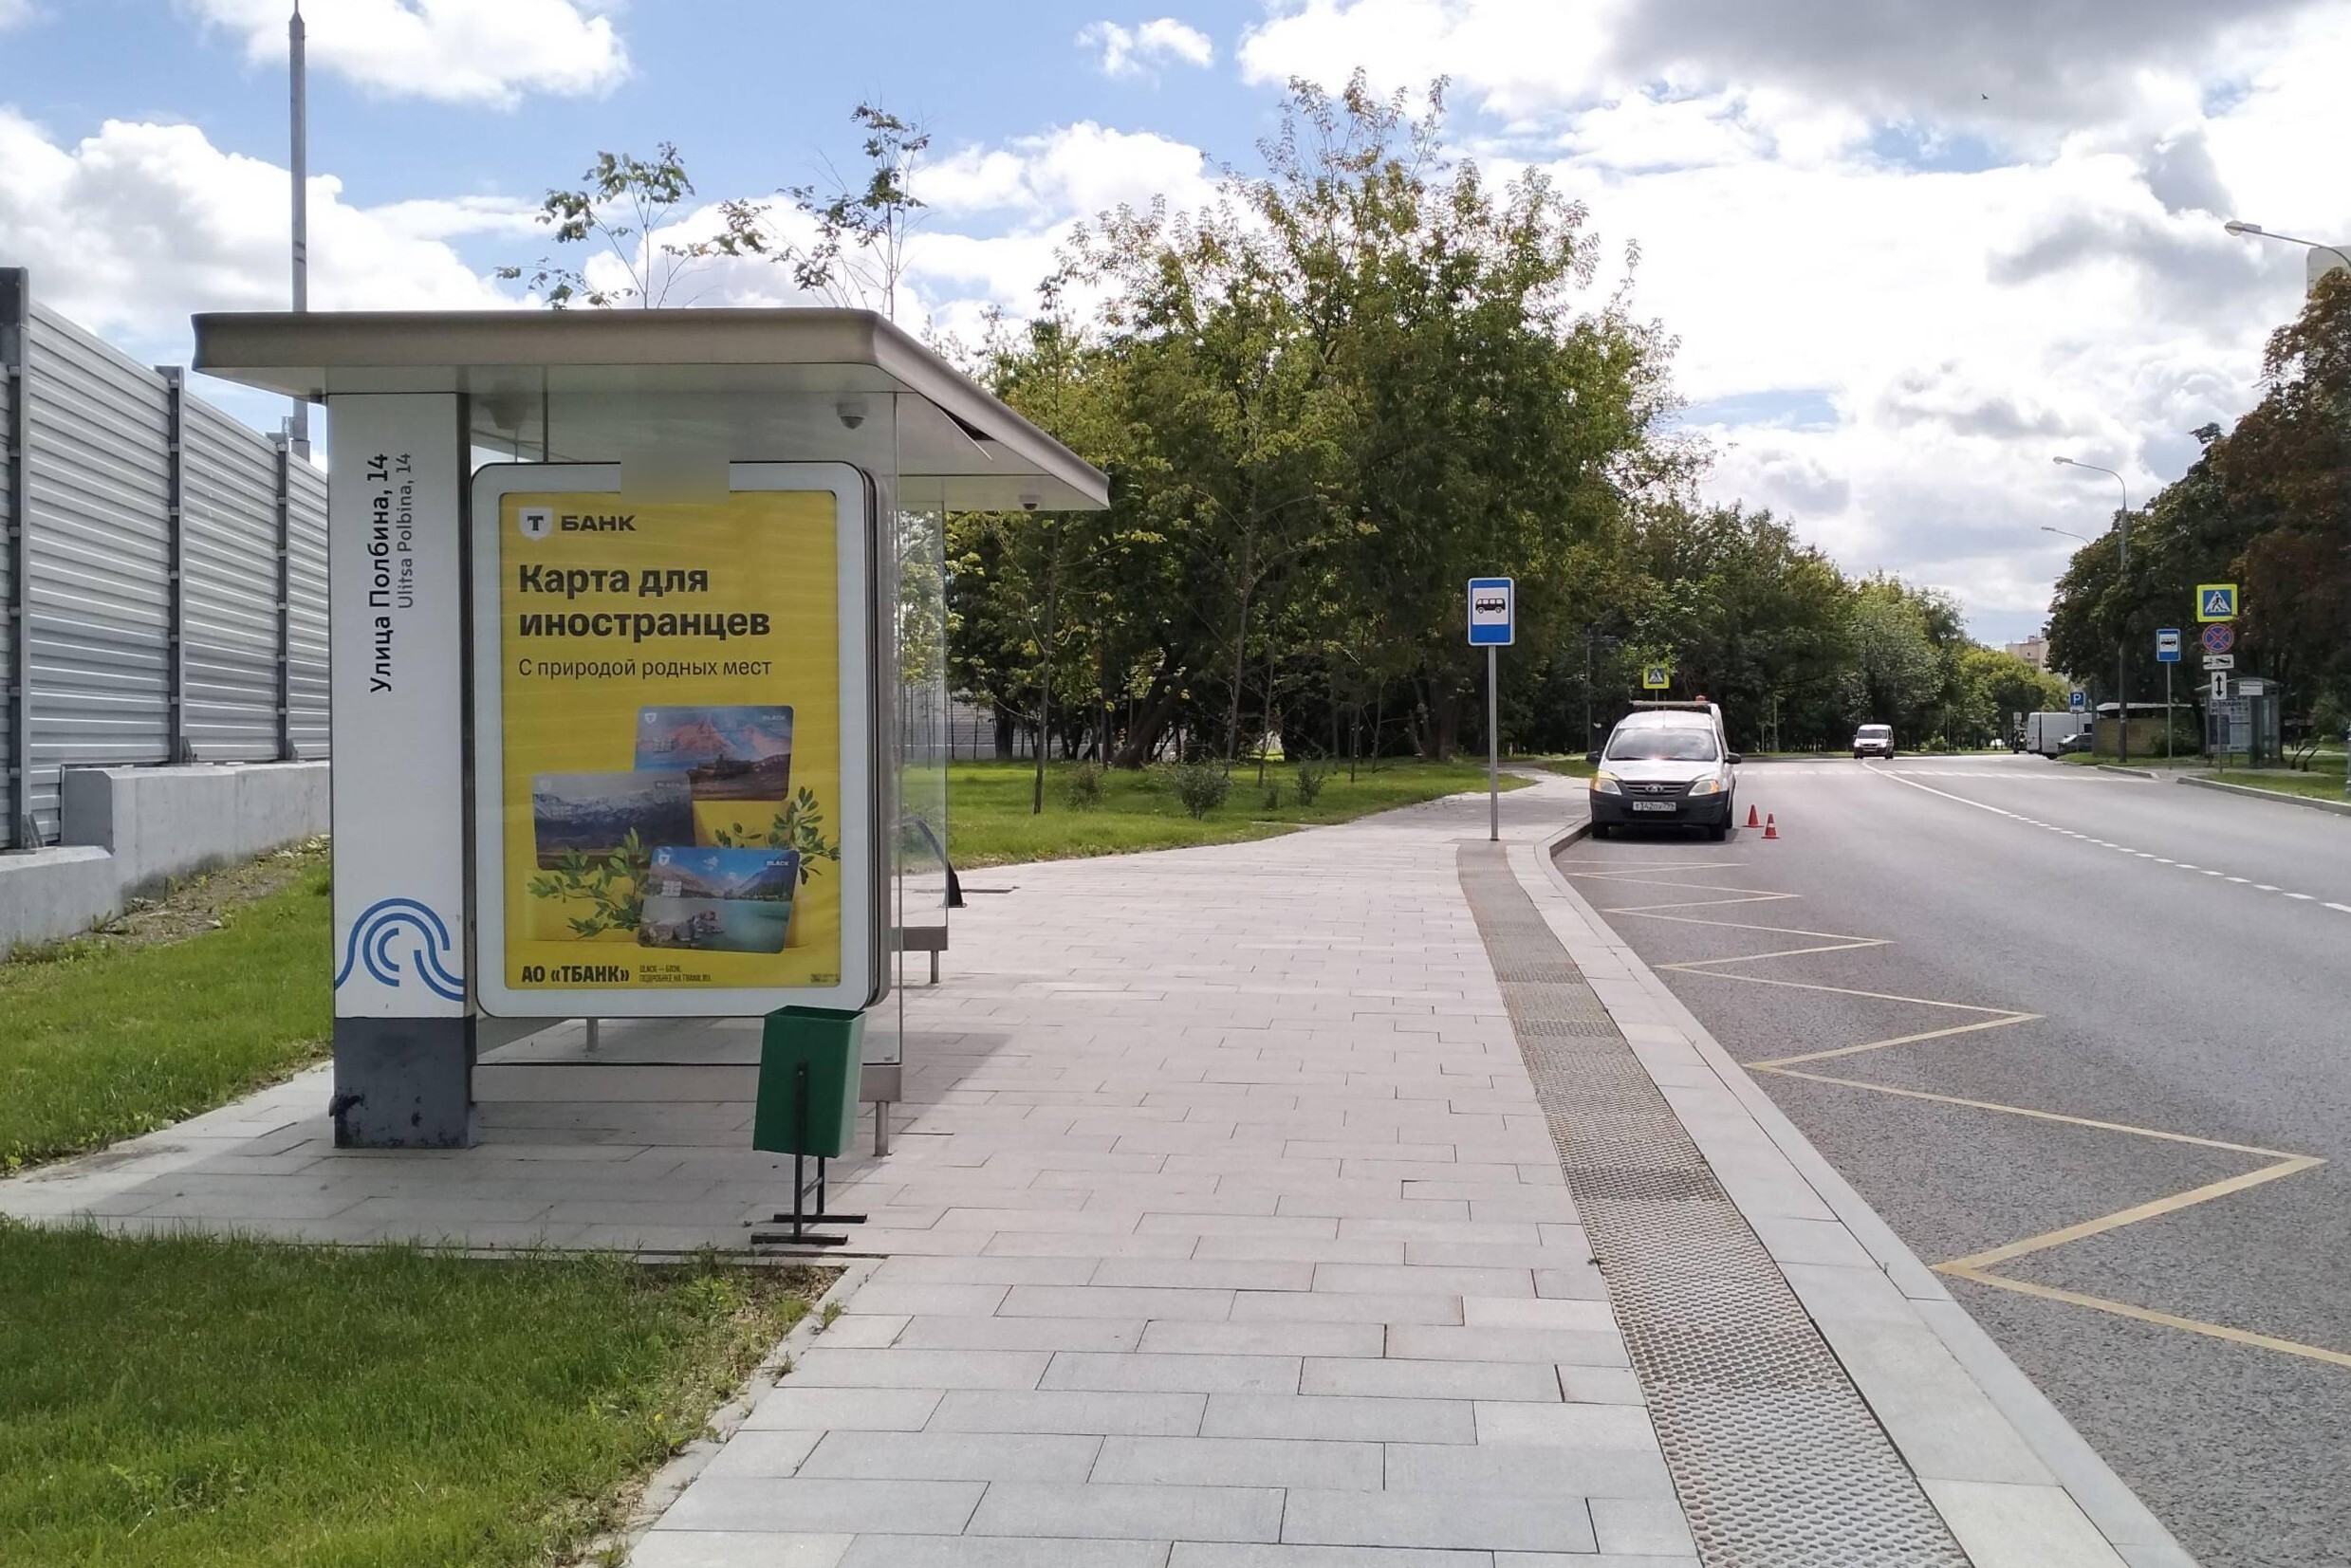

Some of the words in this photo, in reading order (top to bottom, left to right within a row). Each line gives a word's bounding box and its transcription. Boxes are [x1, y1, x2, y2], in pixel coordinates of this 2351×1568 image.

[366, 453, 389, 482] 14
[395, 452, 412, 473] 14
[396, 479, 415, 552] Polbina,
[561, 515, 637, 531] БАНК
[367, 489, 393, 608] Полбина,
[397, 558, 414, 609] Ulitsa
[518, 564, 630, 600] Карта
[638, 569, 709, 598] для
[519, 612, 770, 643] иностранцев
[369, 616, 394, 693] Улица
[518, 658, 532, 676] С
[538, 658, 636, 679] природой
[642, 660, 718, 679] родных
[722, 660, 772, 676] мест
[522, 966, 546, 983] АО
[550, 965, 630, 983] «ТБАНК»
